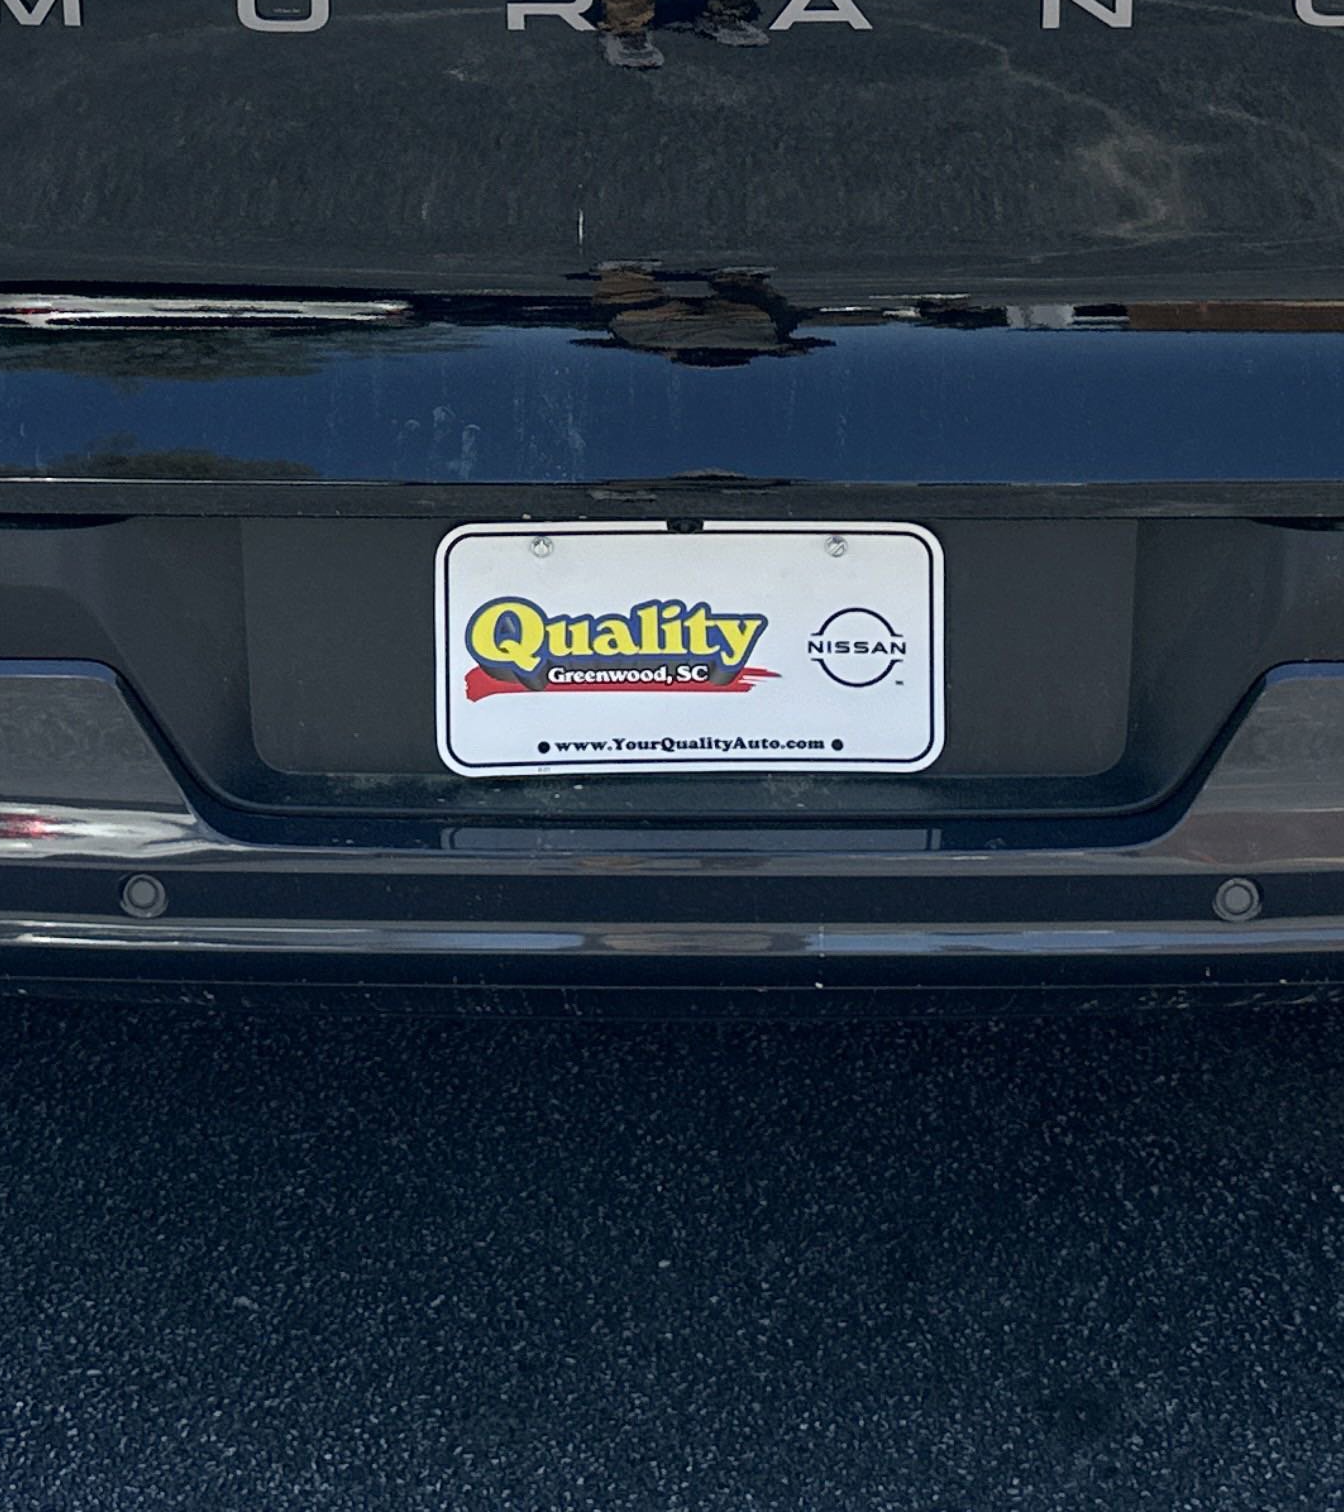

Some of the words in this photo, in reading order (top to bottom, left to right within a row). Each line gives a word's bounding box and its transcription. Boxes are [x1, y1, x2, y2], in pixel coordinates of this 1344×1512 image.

[470, 600, 762, 672] Quality
[807, 640, 906, 655] NISSAN
[547, 666, 672, 685] Greenwood,
[676, 665, 708, 683] SC
[555, 737, 825, 752] www.YourQualityAuto.com
